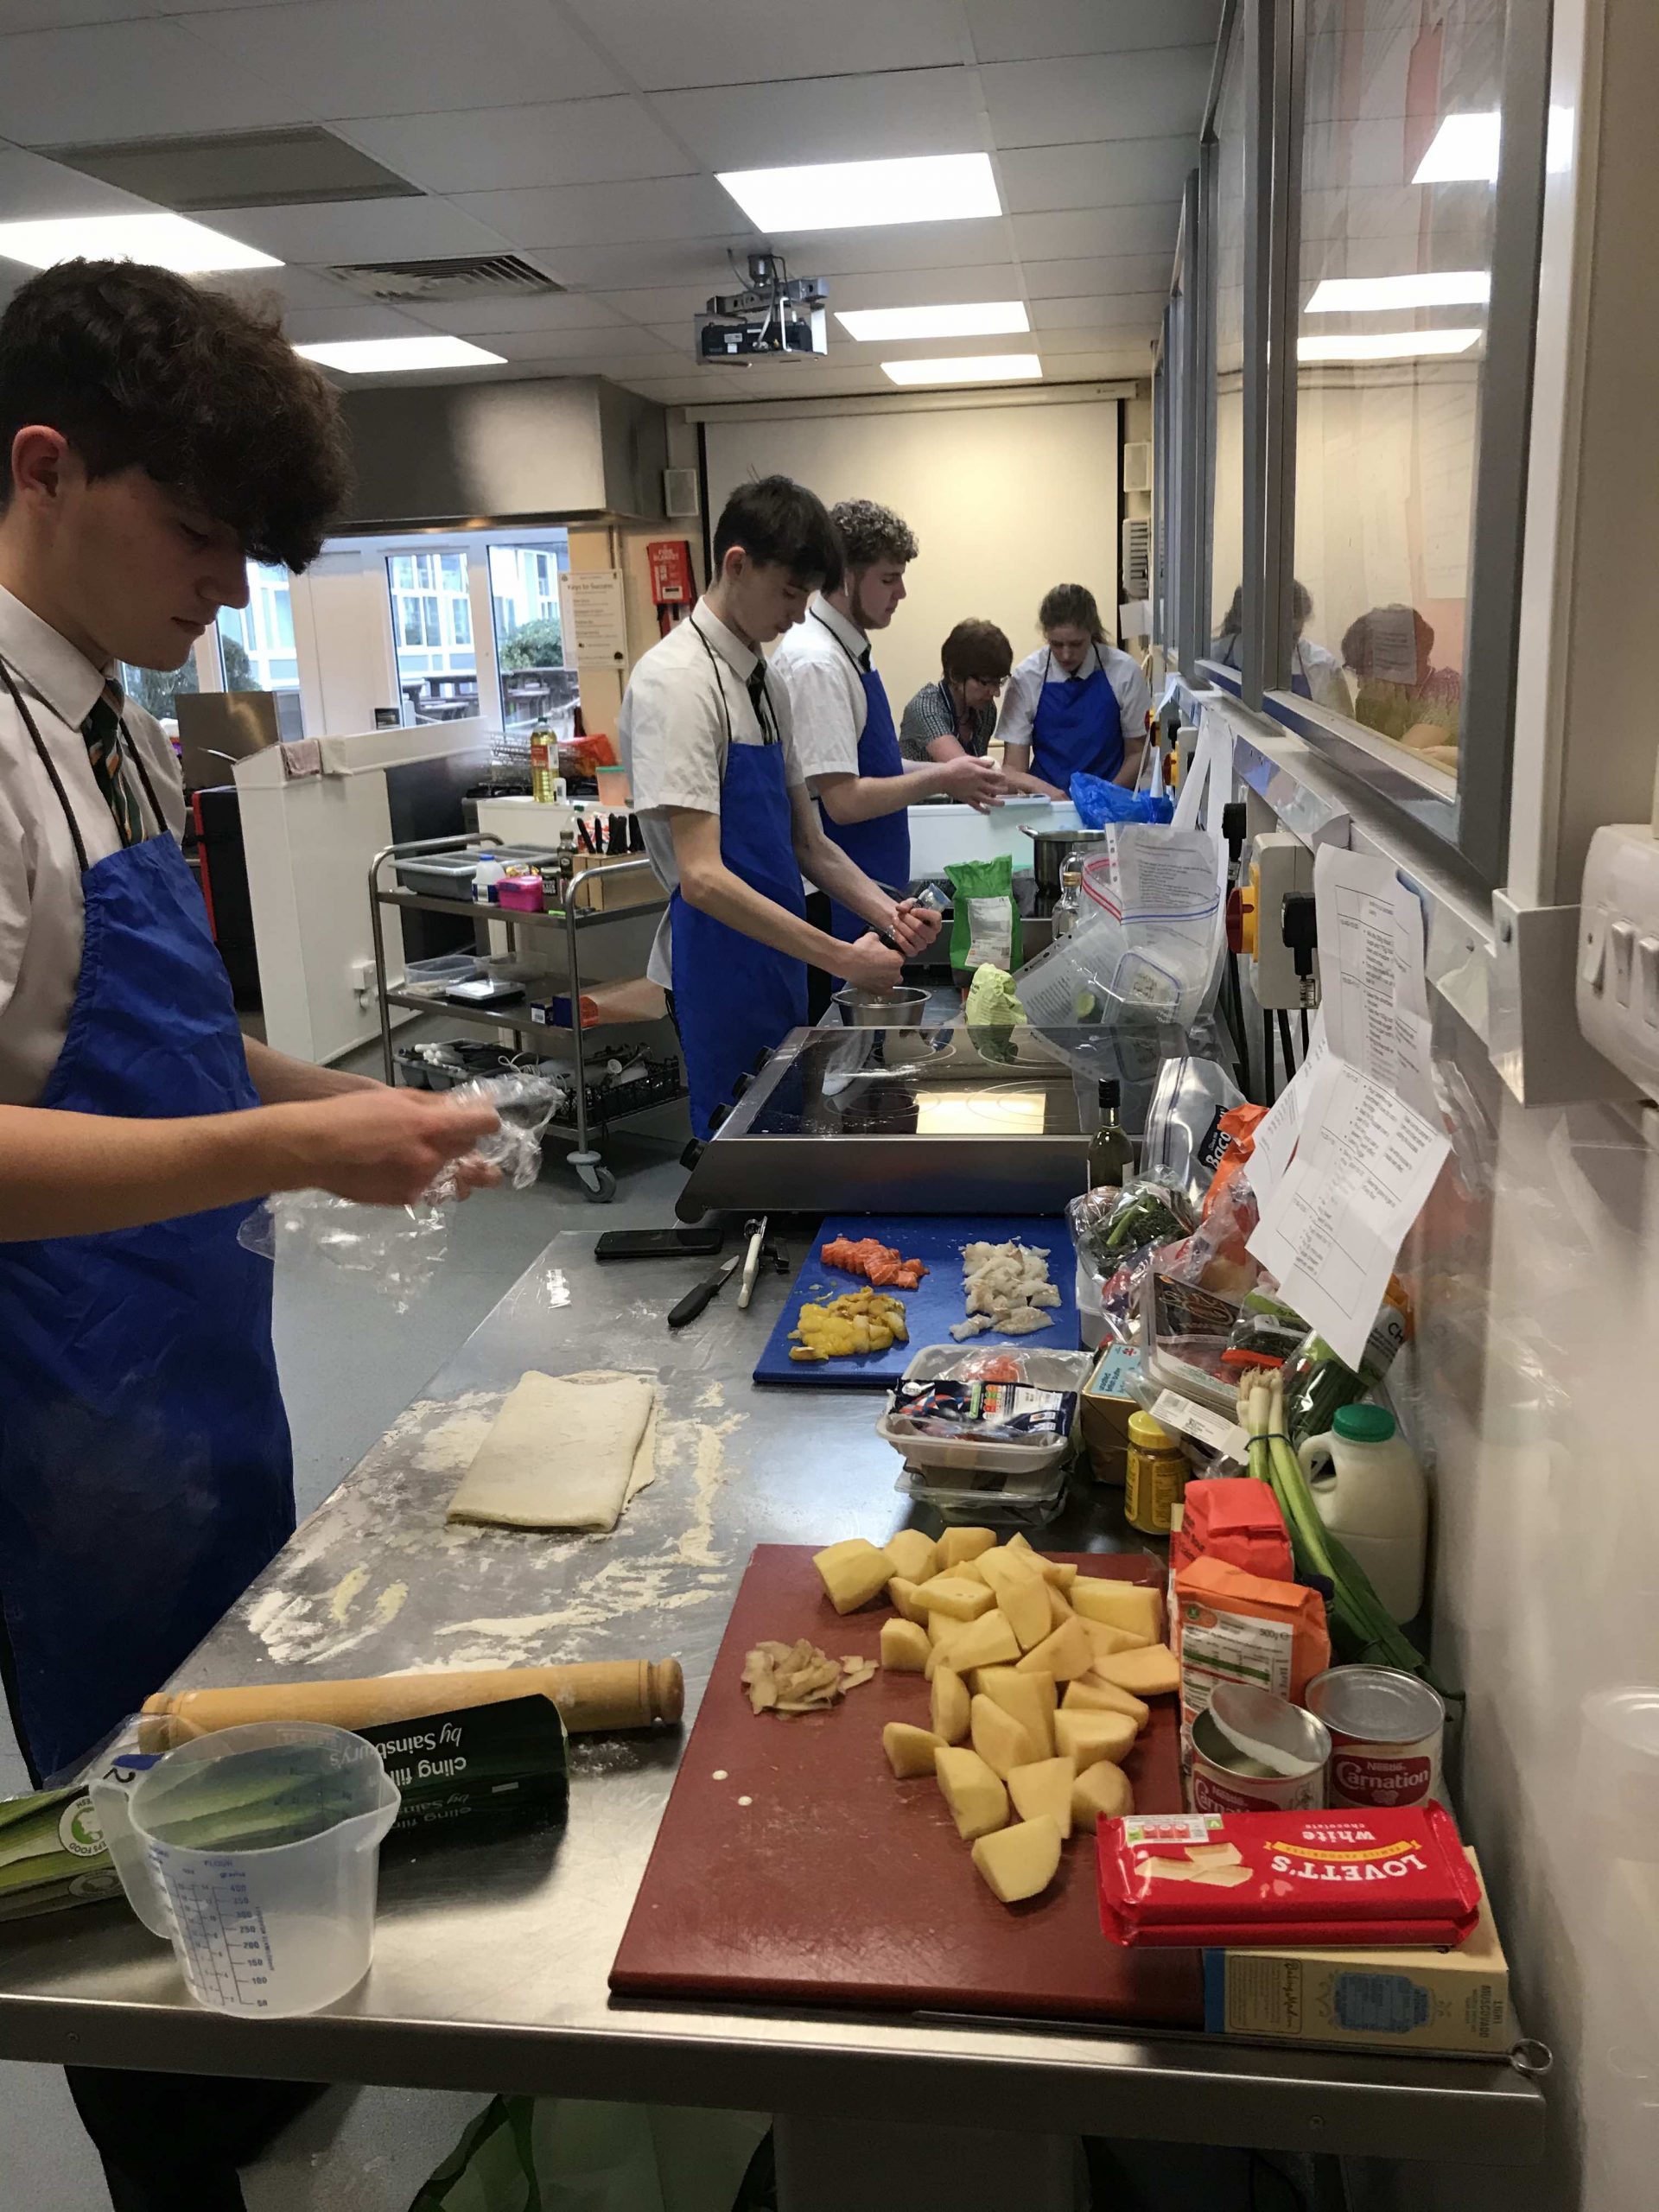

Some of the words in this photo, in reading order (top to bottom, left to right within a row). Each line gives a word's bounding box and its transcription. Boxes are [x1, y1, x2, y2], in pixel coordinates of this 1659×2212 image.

[439, 1723, 462, 1746] by
[417, 1757, 467, 1778] cling
[1337, 1761, 1428, 1790] Carnation
[69, 1842, 92, 1854] FOOD
[1303, 1830, 1376, 1844] white
[1271, 1853, 1427, 1882] LOVETT'S
